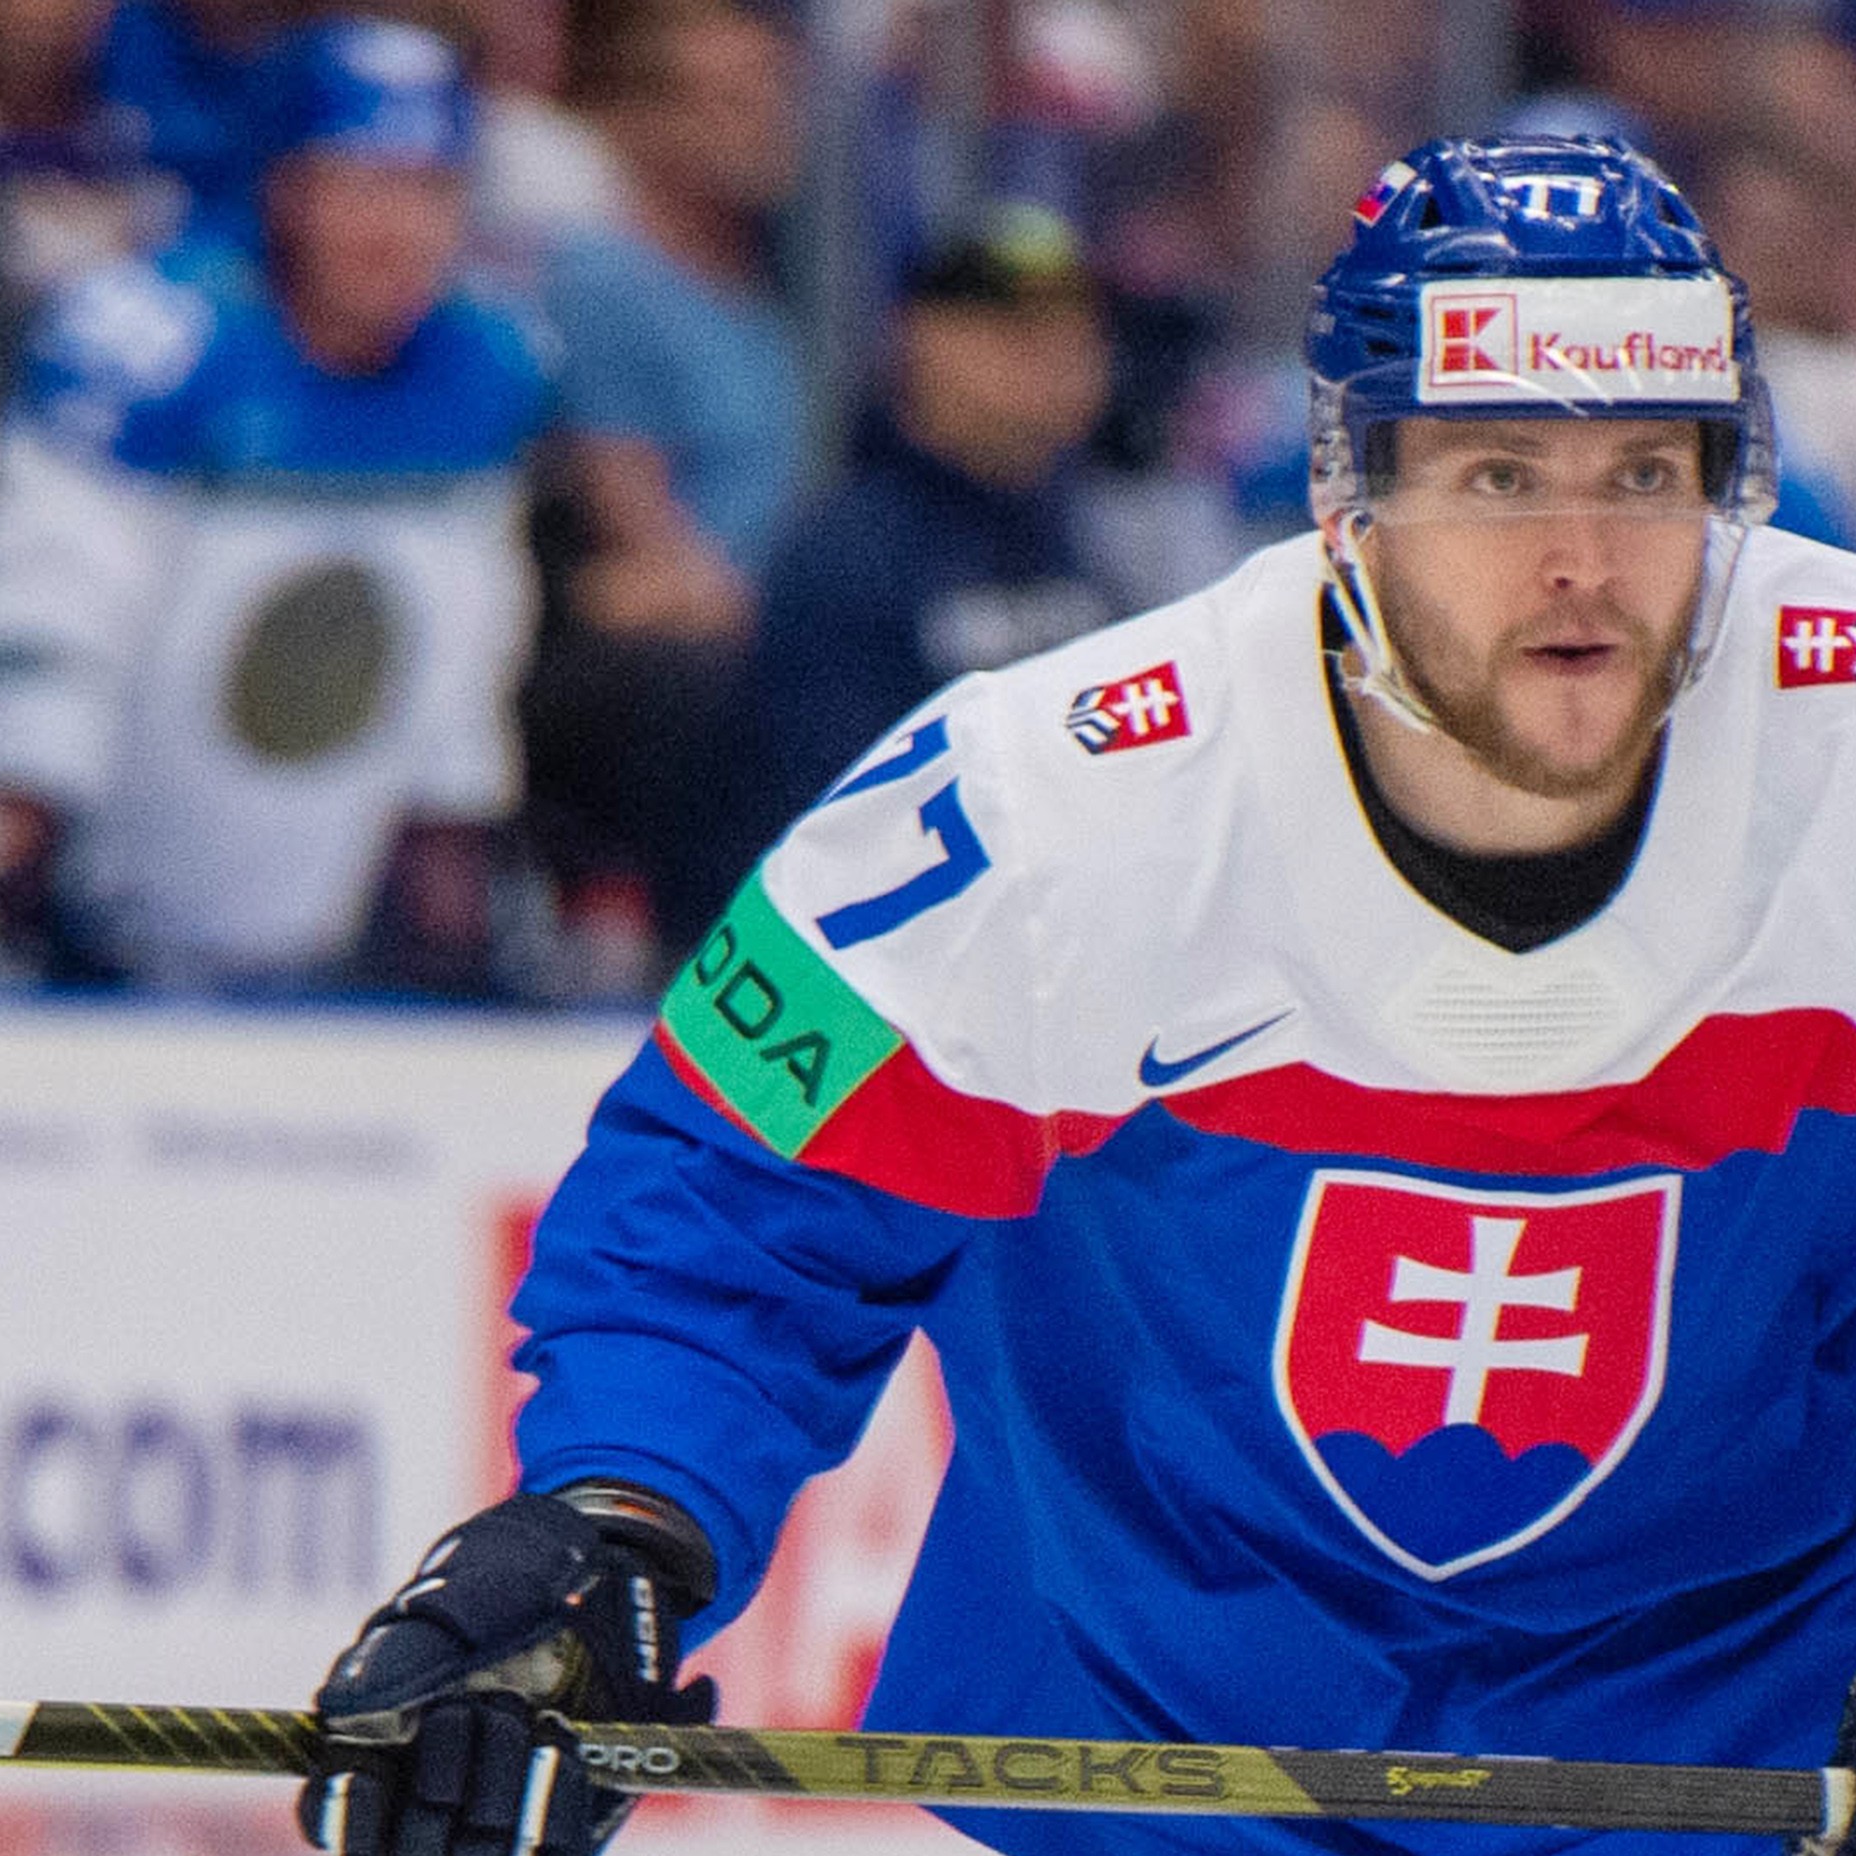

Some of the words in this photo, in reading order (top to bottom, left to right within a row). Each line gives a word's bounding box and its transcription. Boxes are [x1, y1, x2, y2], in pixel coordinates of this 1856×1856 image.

[1529, 331, 1727, 371] Kaufland
[696, 922, 832, 1108] ODA
[578, 1743, 681, 1775] PRO
[836, 1737, 1226, 1799] TACKS
